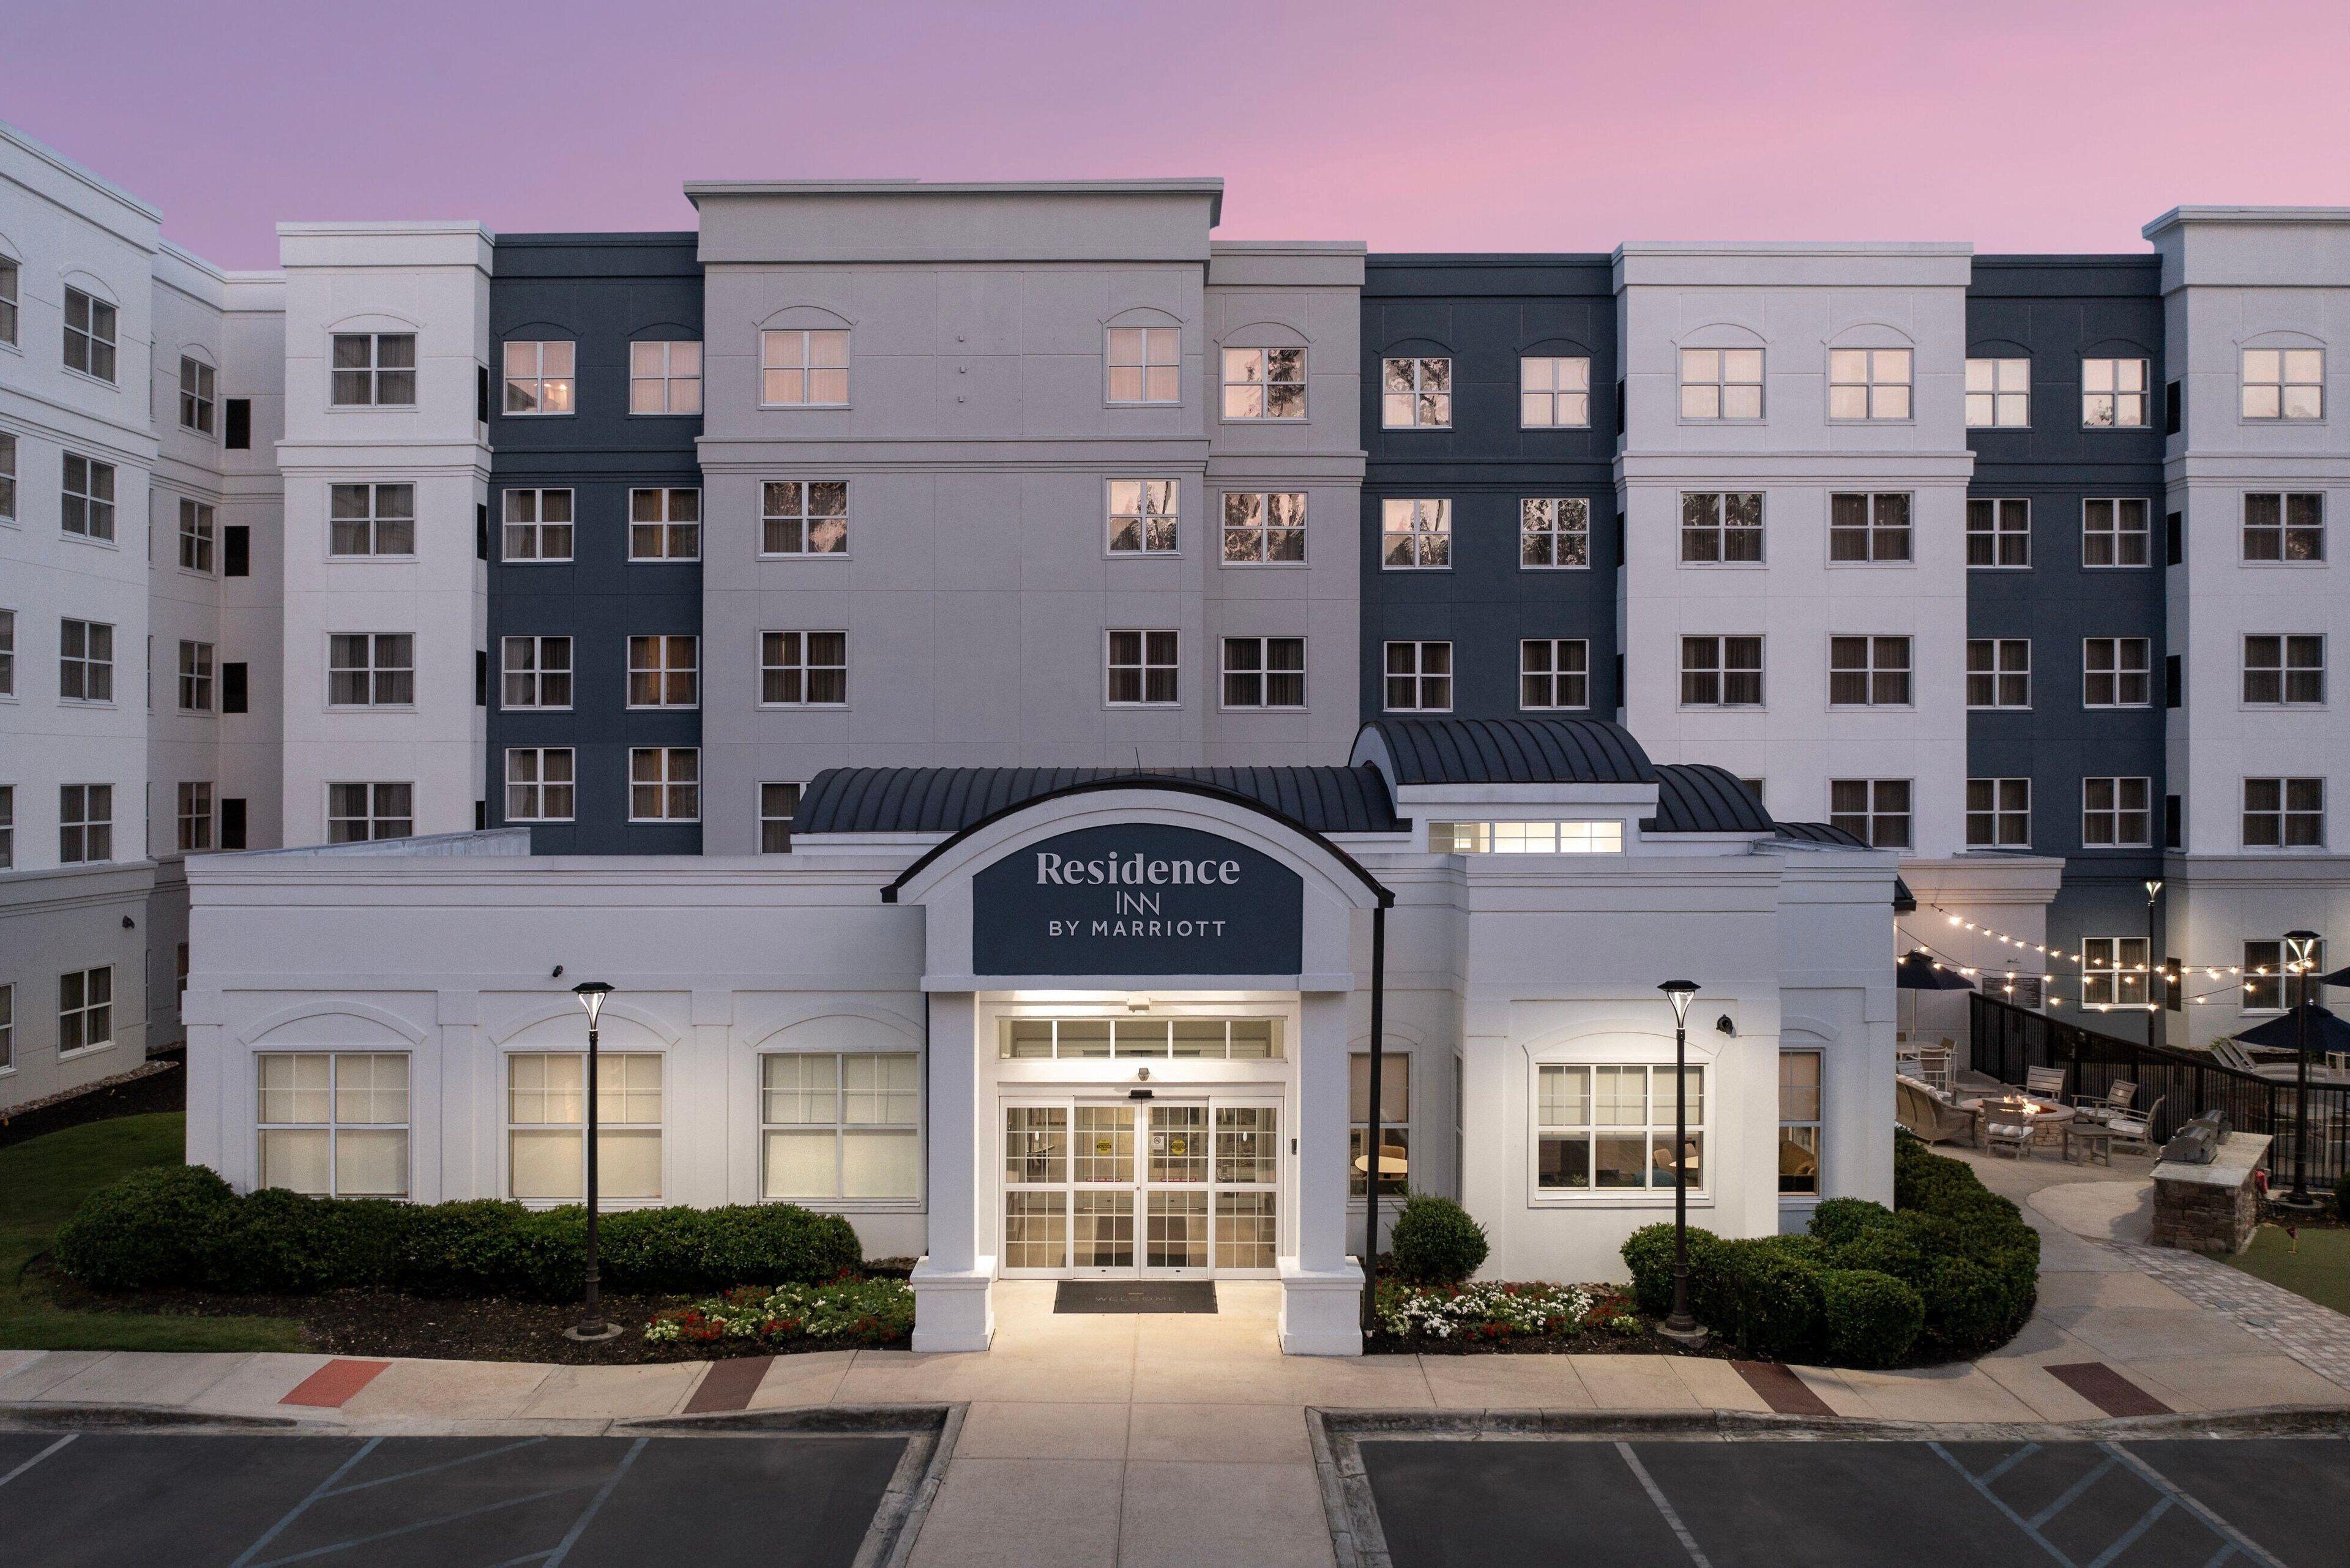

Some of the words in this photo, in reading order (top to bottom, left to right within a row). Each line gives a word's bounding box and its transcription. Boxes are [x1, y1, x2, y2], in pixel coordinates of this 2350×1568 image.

[1037, 851, 1240, 885] Residence
[1116, 890, 1160, 916] INN
[1049, 920, 1080, 936] BY
[1092, 920, 1226, 936] MARRIOTT
